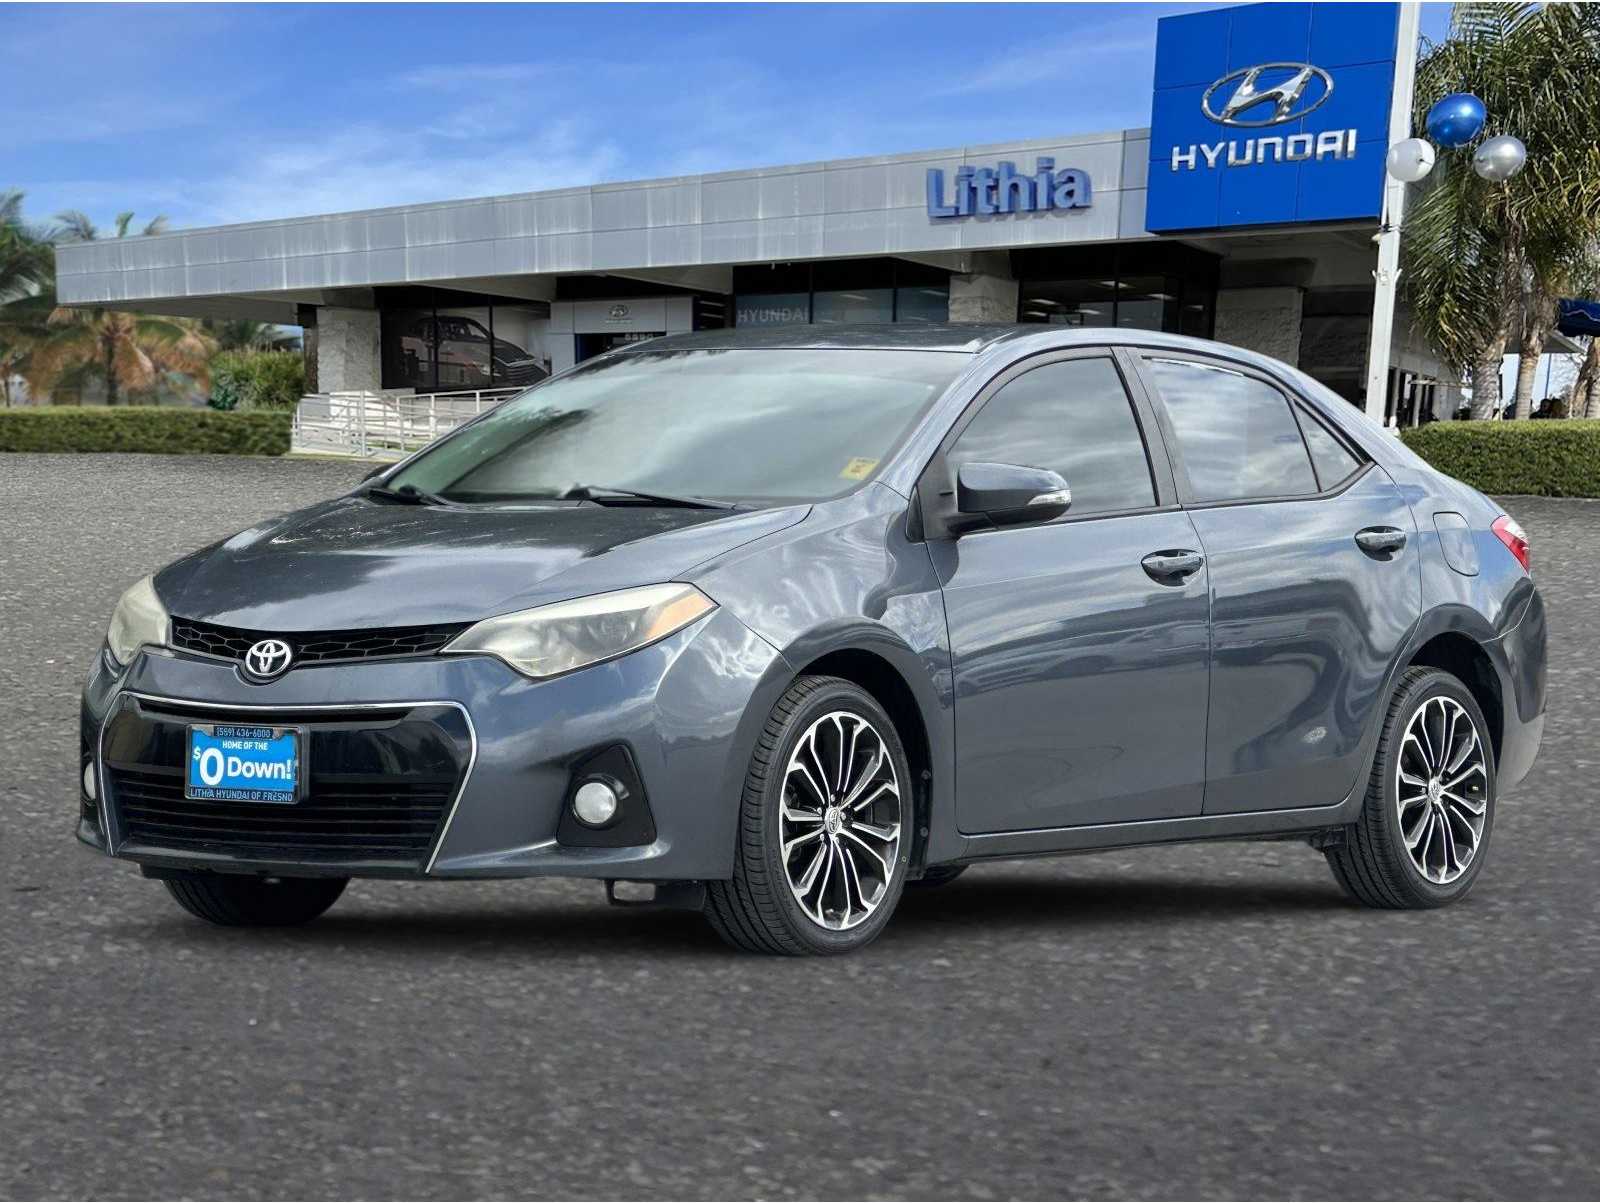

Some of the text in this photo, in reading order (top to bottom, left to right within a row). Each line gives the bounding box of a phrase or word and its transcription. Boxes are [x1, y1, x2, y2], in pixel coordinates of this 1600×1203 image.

[1170, 128, 1358, 171] HYUNDAI
[926, 156, 1092, 218] Lithia
[216, 727, 235, 737] (559)
[222, 740, 268, 751] HOME OF THE
[227, 756, 292, 780] Down!
[190, 787, 293, 802] LITHIA HYUNDAI OF FRESNO
